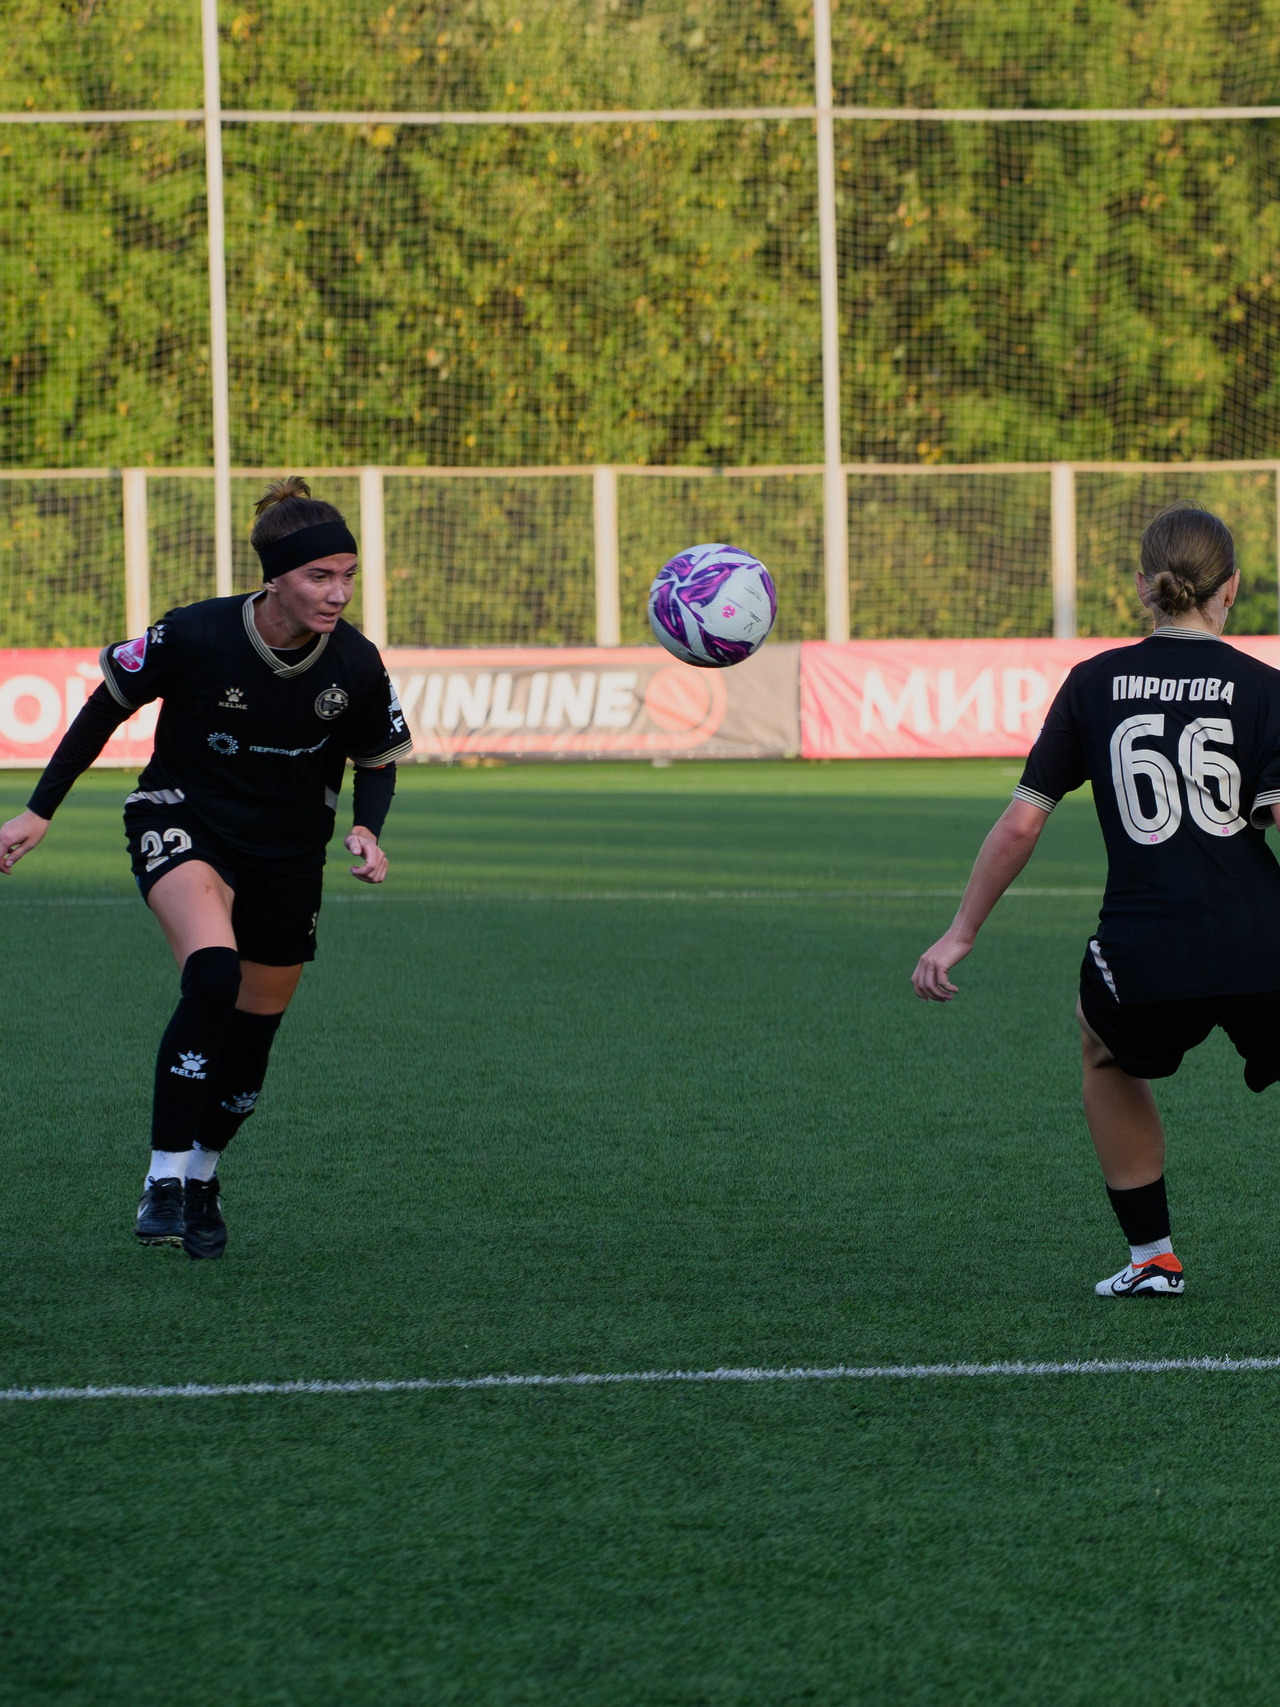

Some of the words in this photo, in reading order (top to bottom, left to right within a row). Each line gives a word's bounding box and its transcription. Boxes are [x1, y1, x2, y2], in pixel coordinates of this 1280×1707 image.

[859, 667, 1050, 734] МИР
[1112, 675, 1234, 705] ПИРОГОВА
[1110, 714, 1247, 845] 66
[170, 1066, 206, 1080] KELME
